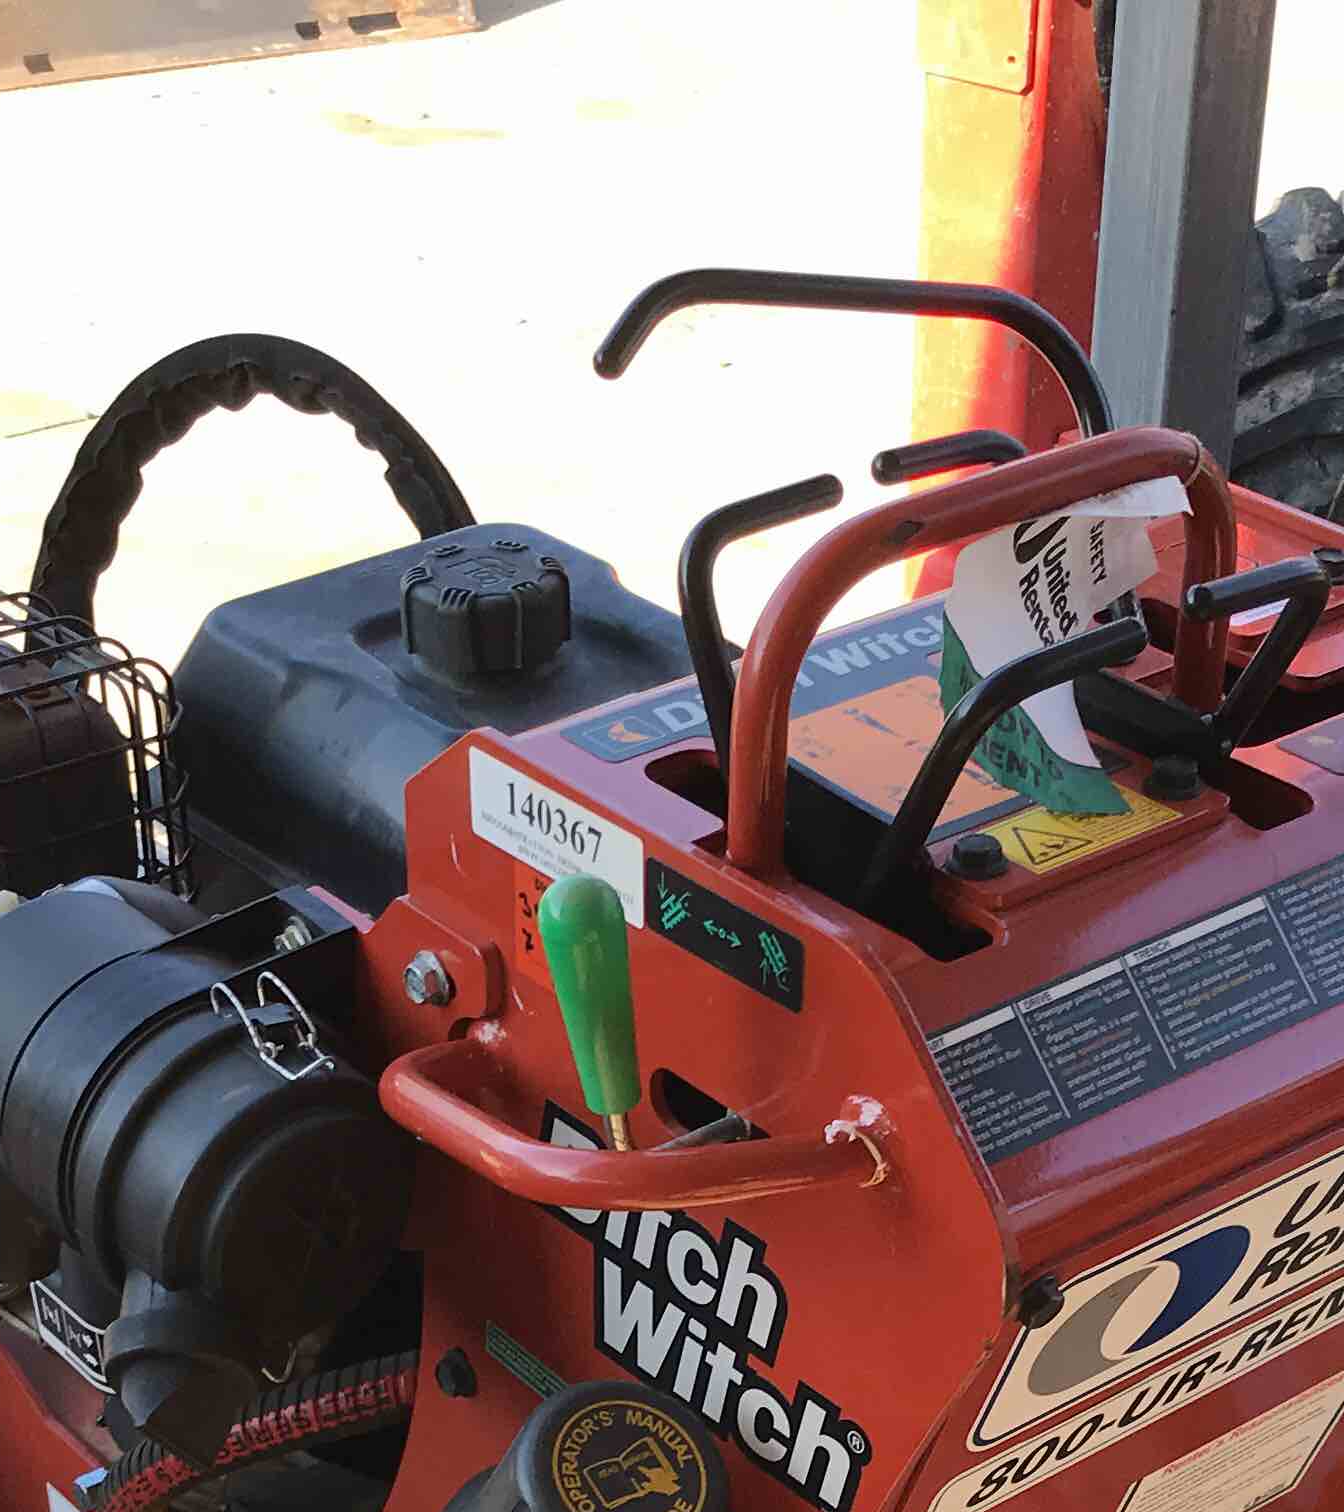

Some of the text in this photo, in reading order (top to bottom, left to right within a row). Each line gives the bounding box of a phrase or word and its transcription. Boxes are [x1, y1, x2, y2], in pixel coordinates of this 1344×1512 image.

[1042, 536, 1079, 637] United
[1088, 519, 1107, 584] SAFETY
[506, 781, 604, 864] 140367
[1133, 938, 1170, 962] TRENCH
[603, 1257, 852, 1509] Witch
[625, 1409, 693, 1469] MANUAL
